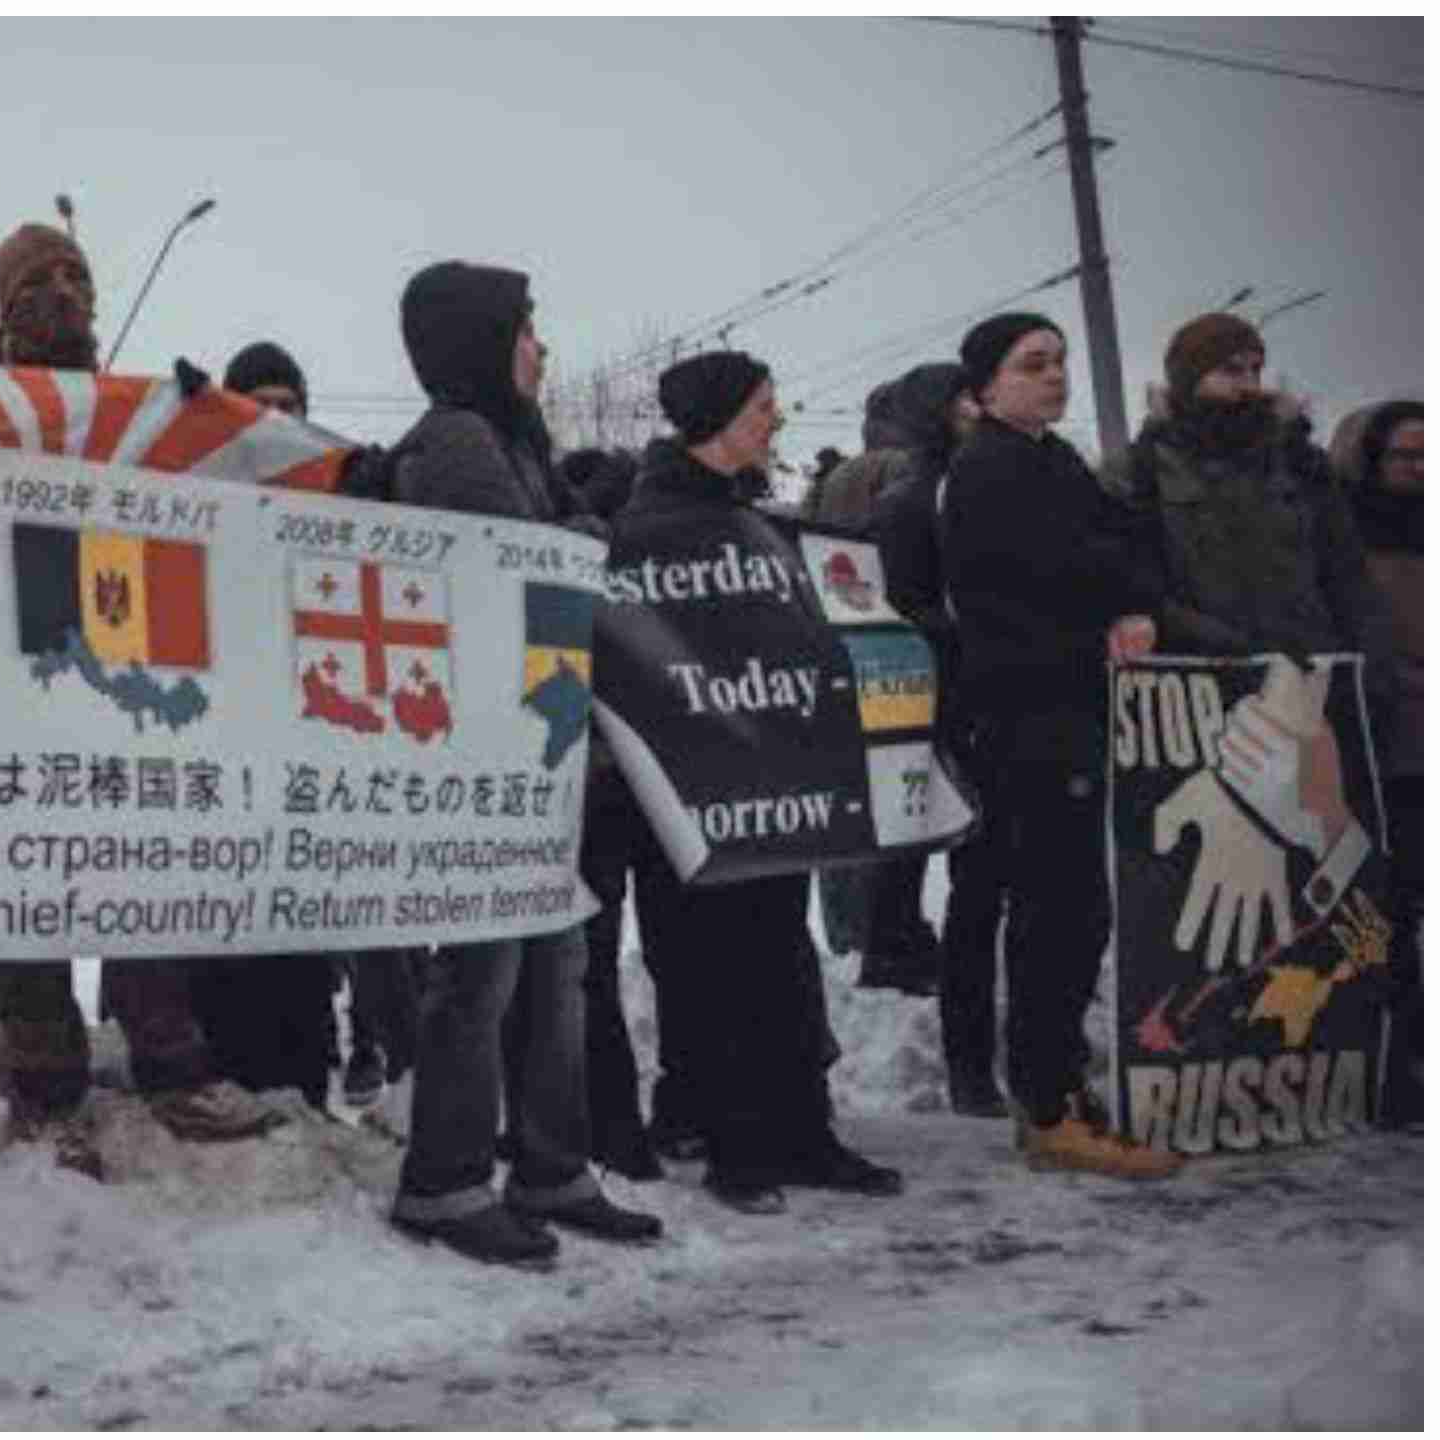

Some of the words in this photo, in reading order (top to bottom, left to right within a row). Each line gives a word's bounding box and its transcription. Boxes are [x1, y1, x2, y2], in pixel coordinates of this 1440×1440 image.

[601, 541, 794, 604] esterday
[668, 657, 819, 719] Today
[1115, 672, 1224, 770] STOP
[6, 824, 274, 880] страна-вор!
[285, 826, 398, 880] Верни
[267, 886, 385, 930] Return
[1127, 1053, 1366, 1152] RUSSIA
